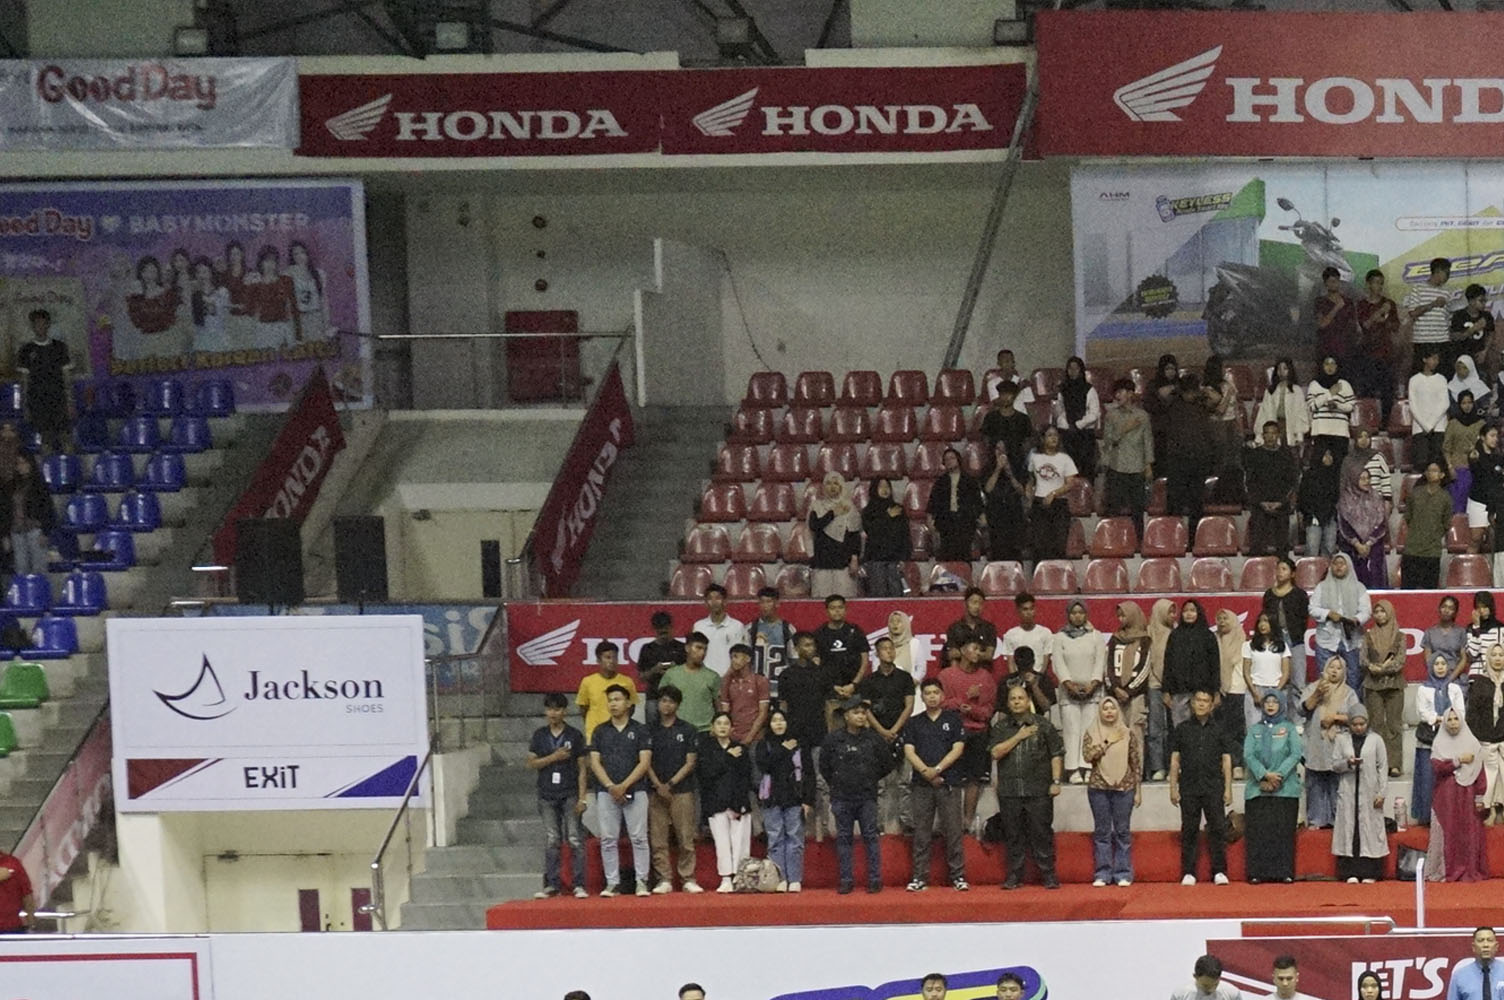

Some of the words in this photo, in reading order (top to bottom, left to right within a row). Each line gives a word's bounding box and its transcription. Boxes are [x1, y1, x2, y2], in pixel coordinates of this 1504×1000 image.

[36, 66, 136, 104] Good
[143, 62, 217, 110] Day
[394, 109, 628, 142] HONDA
[761, 103, 994, 136] HONDA
[243, 670, 385, 701] Jackson
[345, 704, 385, 714] SHOES
